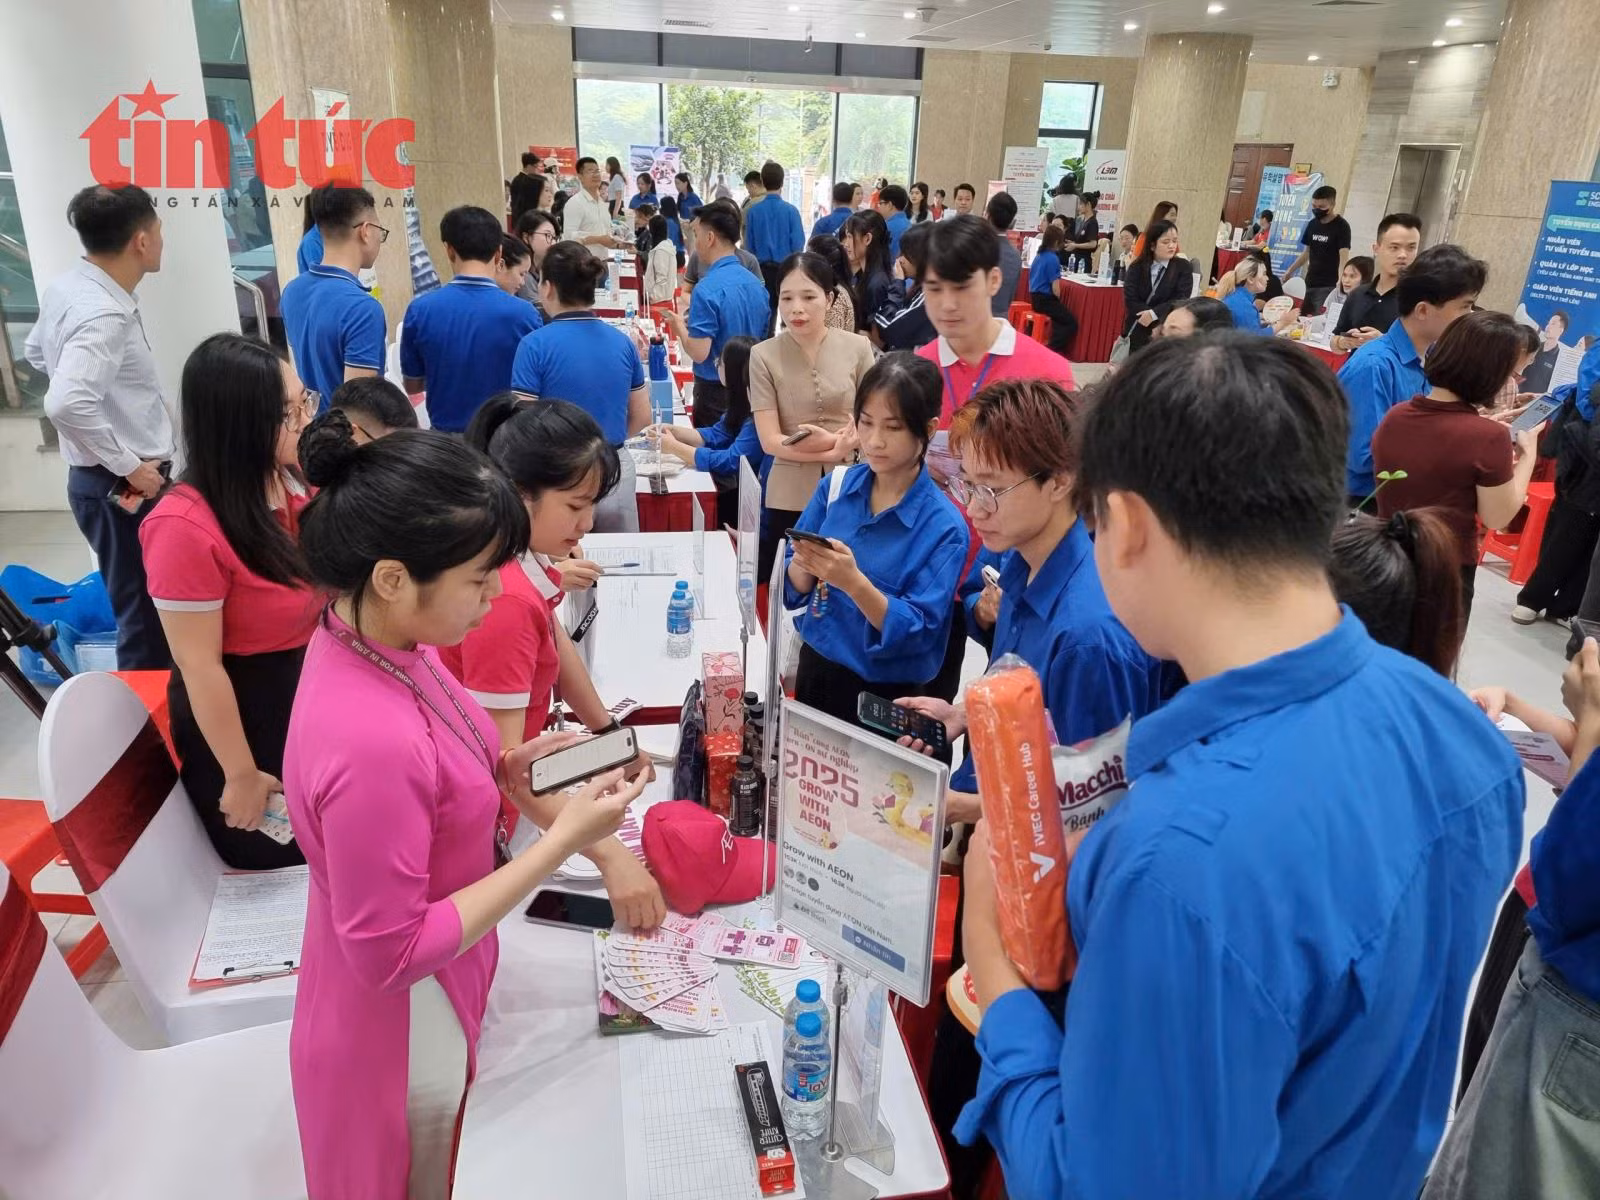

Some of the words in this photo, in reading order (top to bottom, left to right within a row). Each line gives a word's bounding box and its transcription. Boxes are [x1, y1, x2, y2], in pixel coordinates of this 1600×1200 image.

[351, 639, 371, 659] ASIA
[369, 652, 380, 663] IN
[378, 658, 395, 673] FOR
[394, 669, 414, 690] WORK
[1019, 742, 1033, 768] Hub
[784, 748, 859, 808] 2025
[1026, 770, 1040, 809] Career
[799, 778, 835, 803] GROW
[799, 793, 830, 817] WITH
[799, 809, 831, 833] AEON
[782, 841, 806, 858] Grow
[806, 853, 826, 868] with
[827, 863, 854, 882] AEON
[759, 1132, 784, 1145] CUTTER
[760, 1125, 779, 1138] KNIFE
